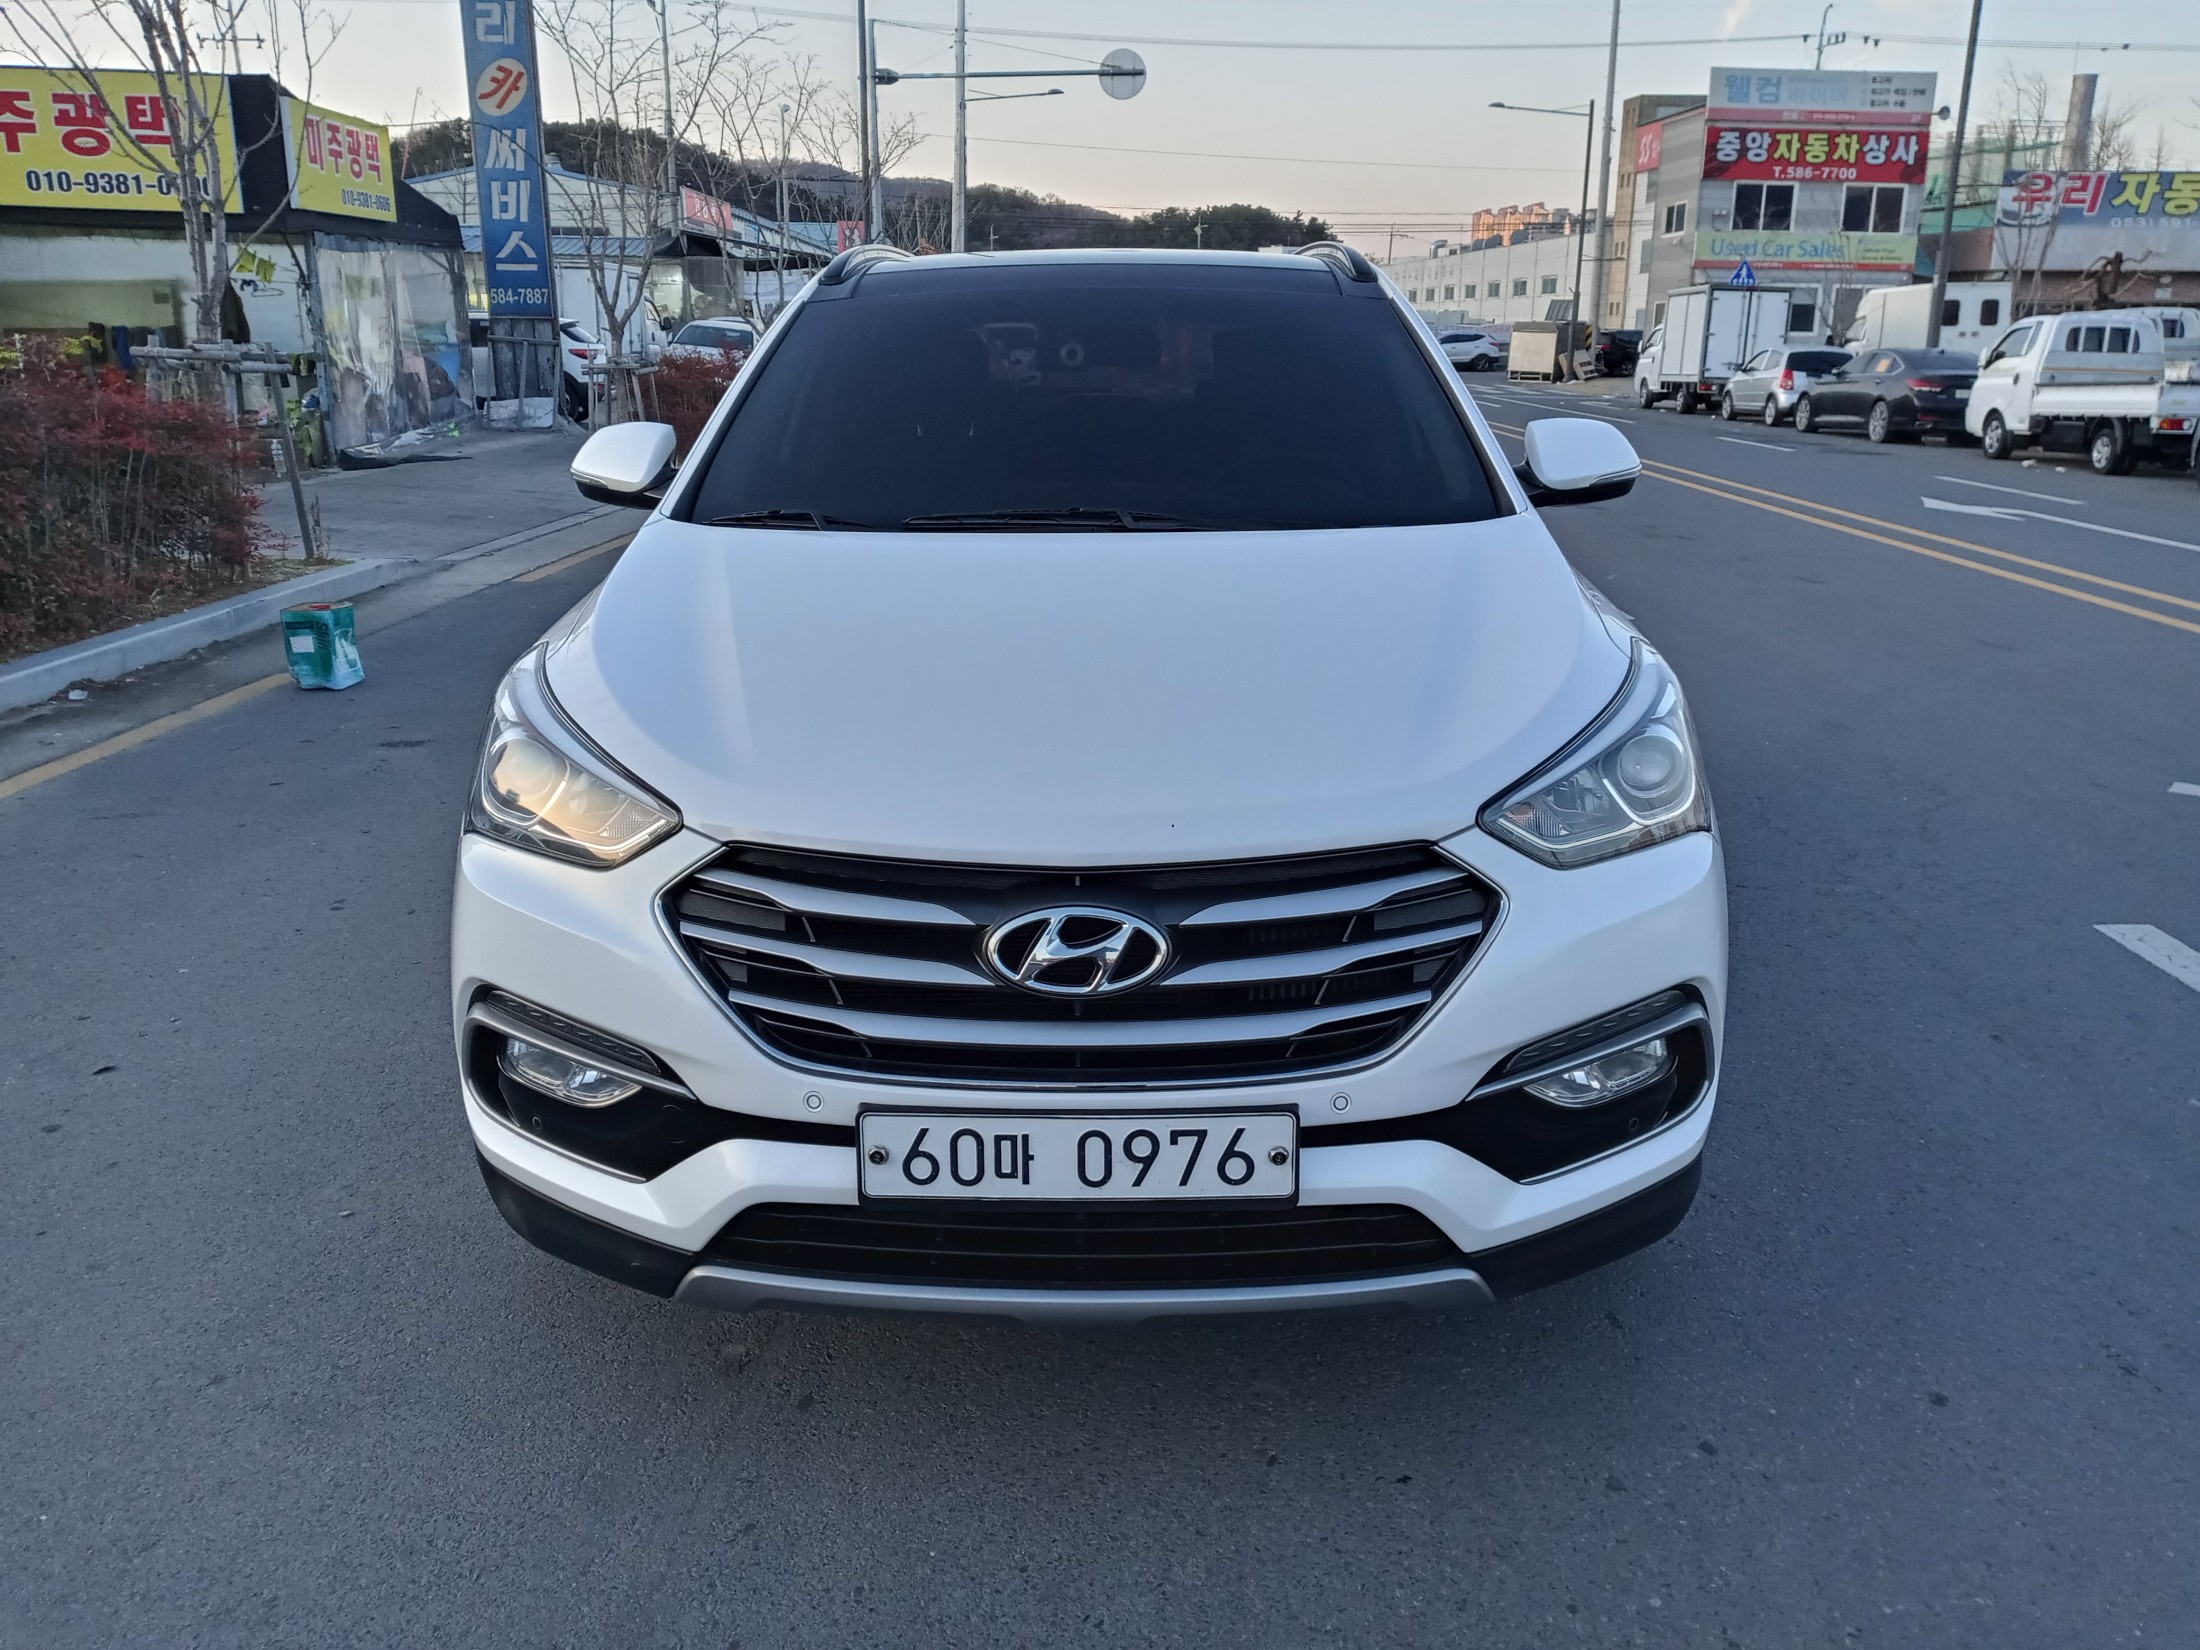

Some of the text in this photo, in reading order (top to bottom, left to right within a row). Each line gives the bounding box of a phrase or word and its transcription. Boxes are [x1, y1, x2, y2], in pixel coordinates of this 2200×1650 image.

[305, 117, 381, 183] 미주광택
[1716, 131, 1919, 165] 중앙자동차상사
[1772, 166, 1857, 180] T.586-7700
[1711, 238, 1757, 257] Used
[1762, 240, 1793, 257] Car
[1797, 240, 1845, 259] Sales
[490, 288, 548, 304] 584-7887
[901, 1126, 1256, 1188] 60마 0976
